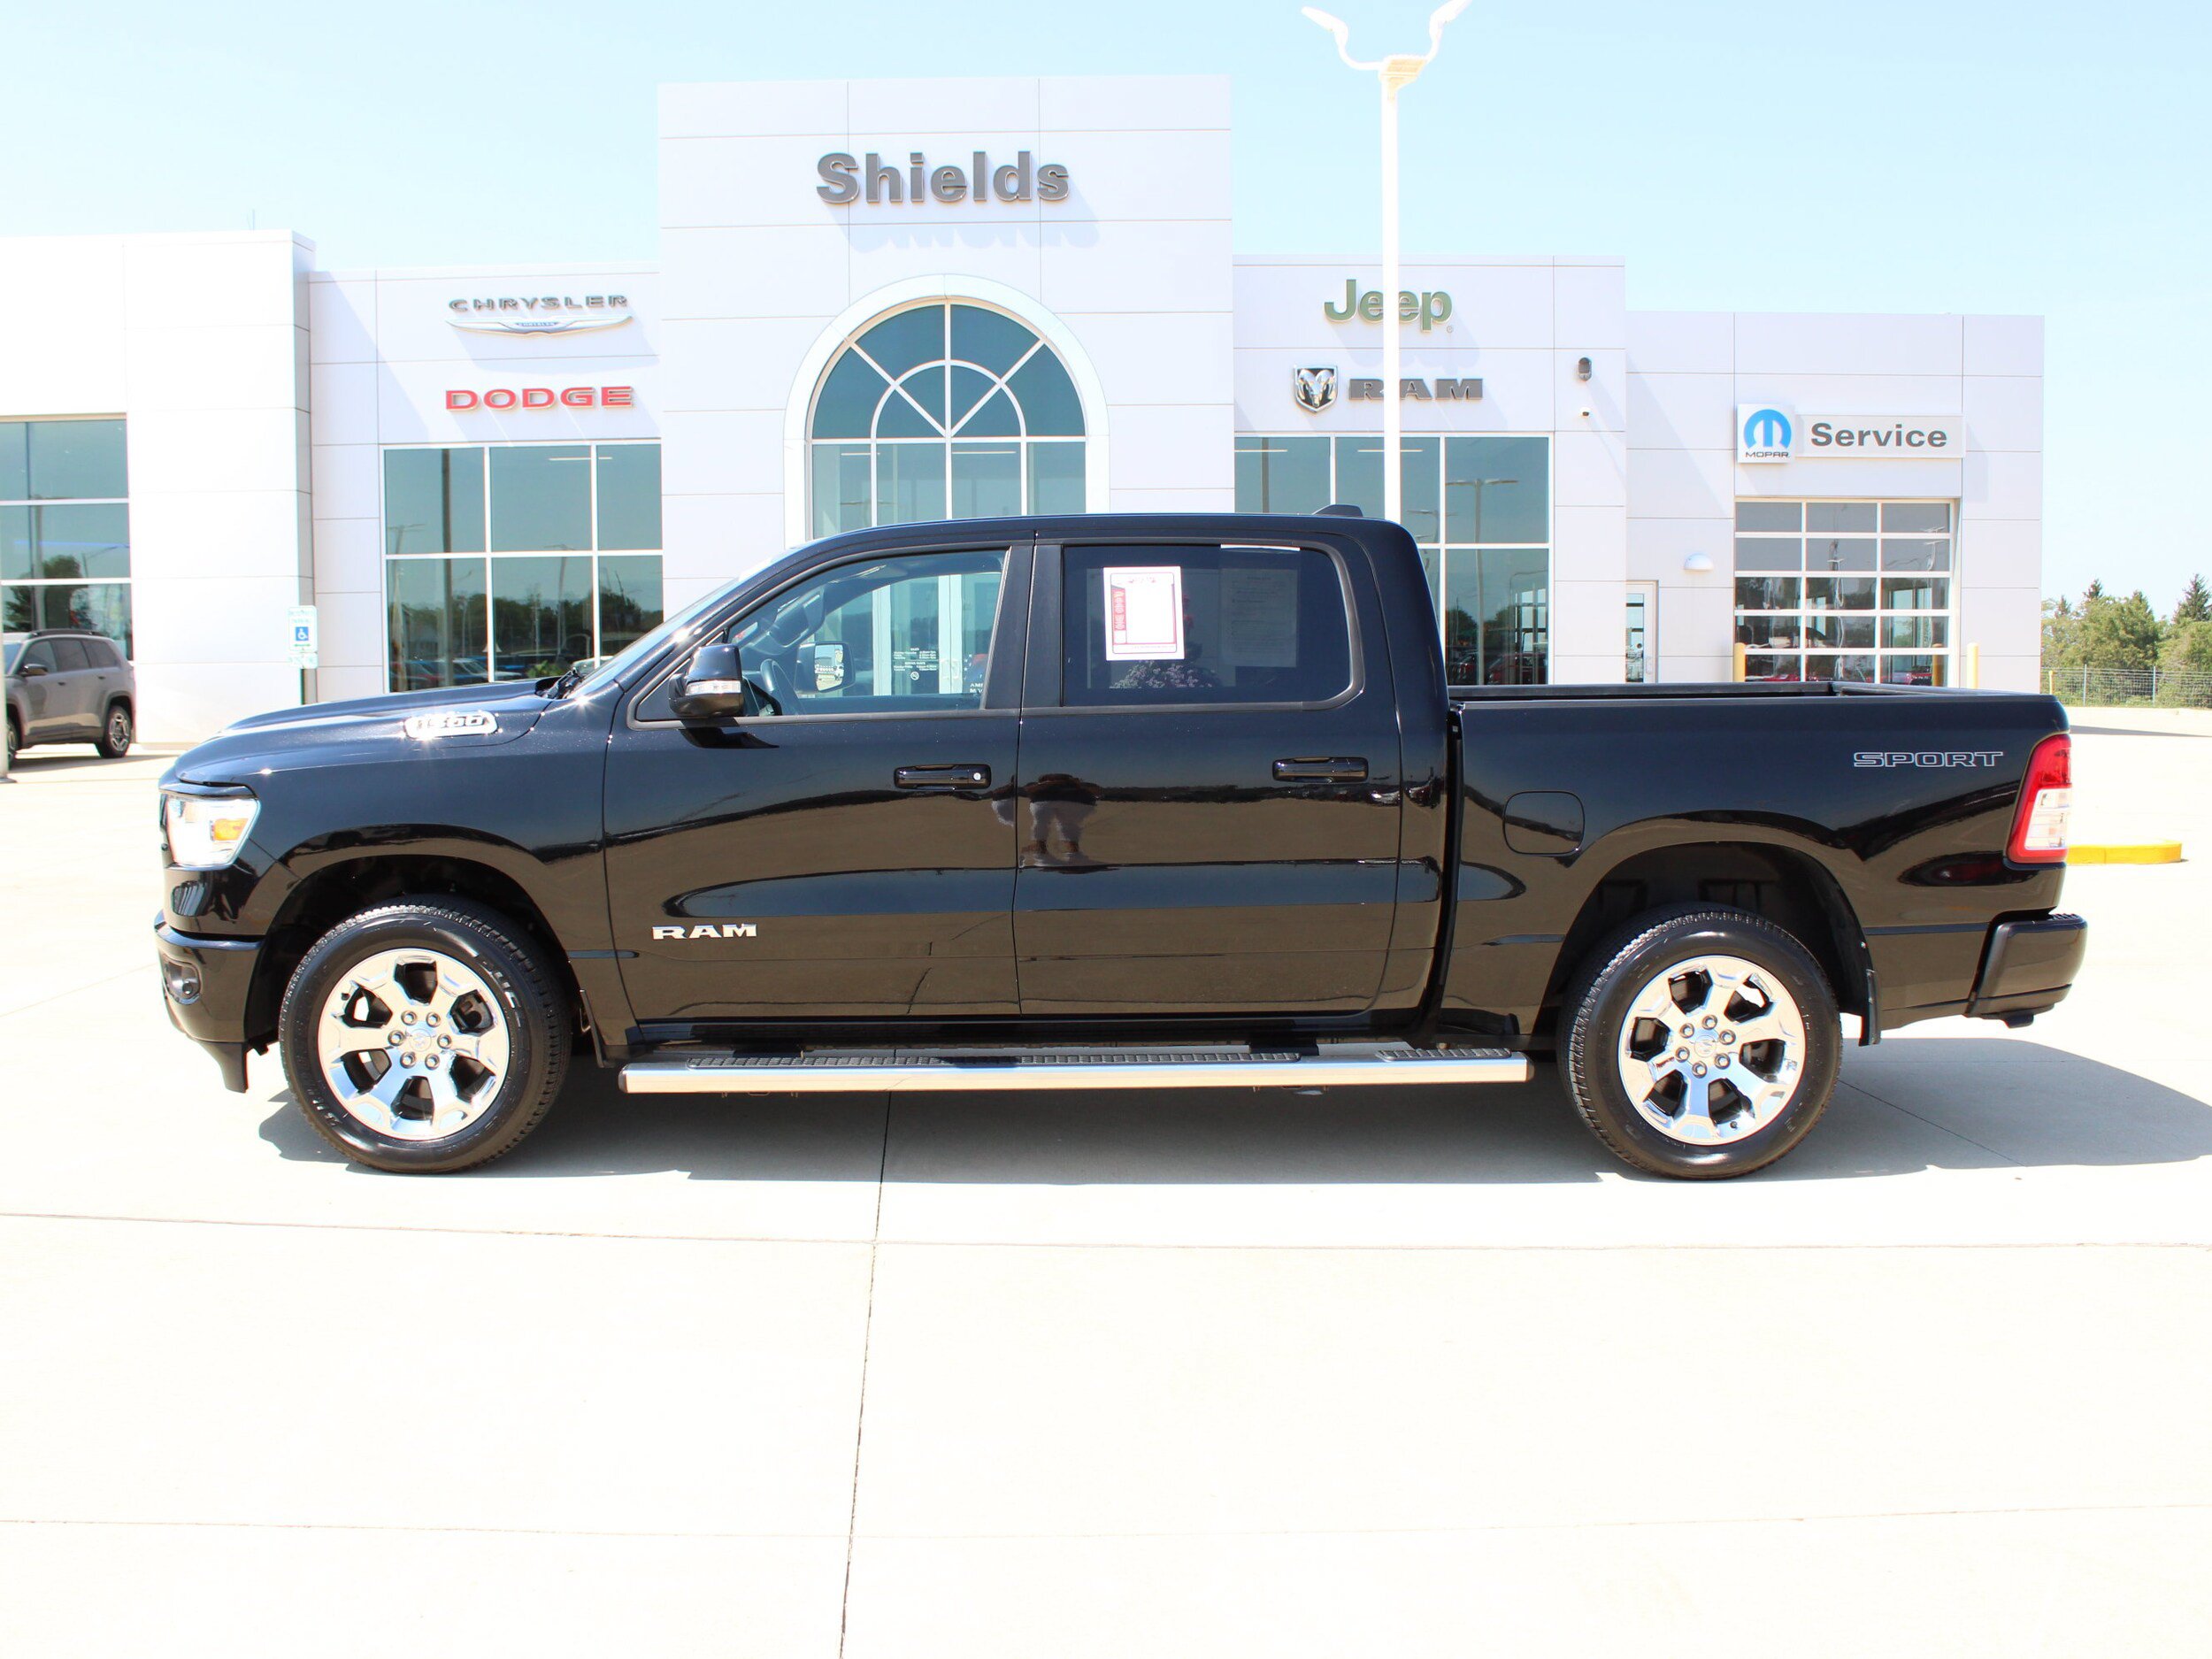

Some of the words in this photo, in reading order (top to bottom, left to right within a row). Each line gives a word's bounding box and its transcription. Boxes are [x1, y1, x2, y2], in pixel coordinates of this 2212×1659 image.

[816, 150, 1071, 204] Shields
[448, 295, 629, 312] CHRYSLER
[1324, 279, 1453, 332] Jeep
[445, 386, 634, 411] DODGE
[1348, 378, 1484, 400] RAM
[1810, 423, 1948, 448] Service
[1853, 751, 2004, 768] SPORT
[651, 923, 758, 940] RAM
